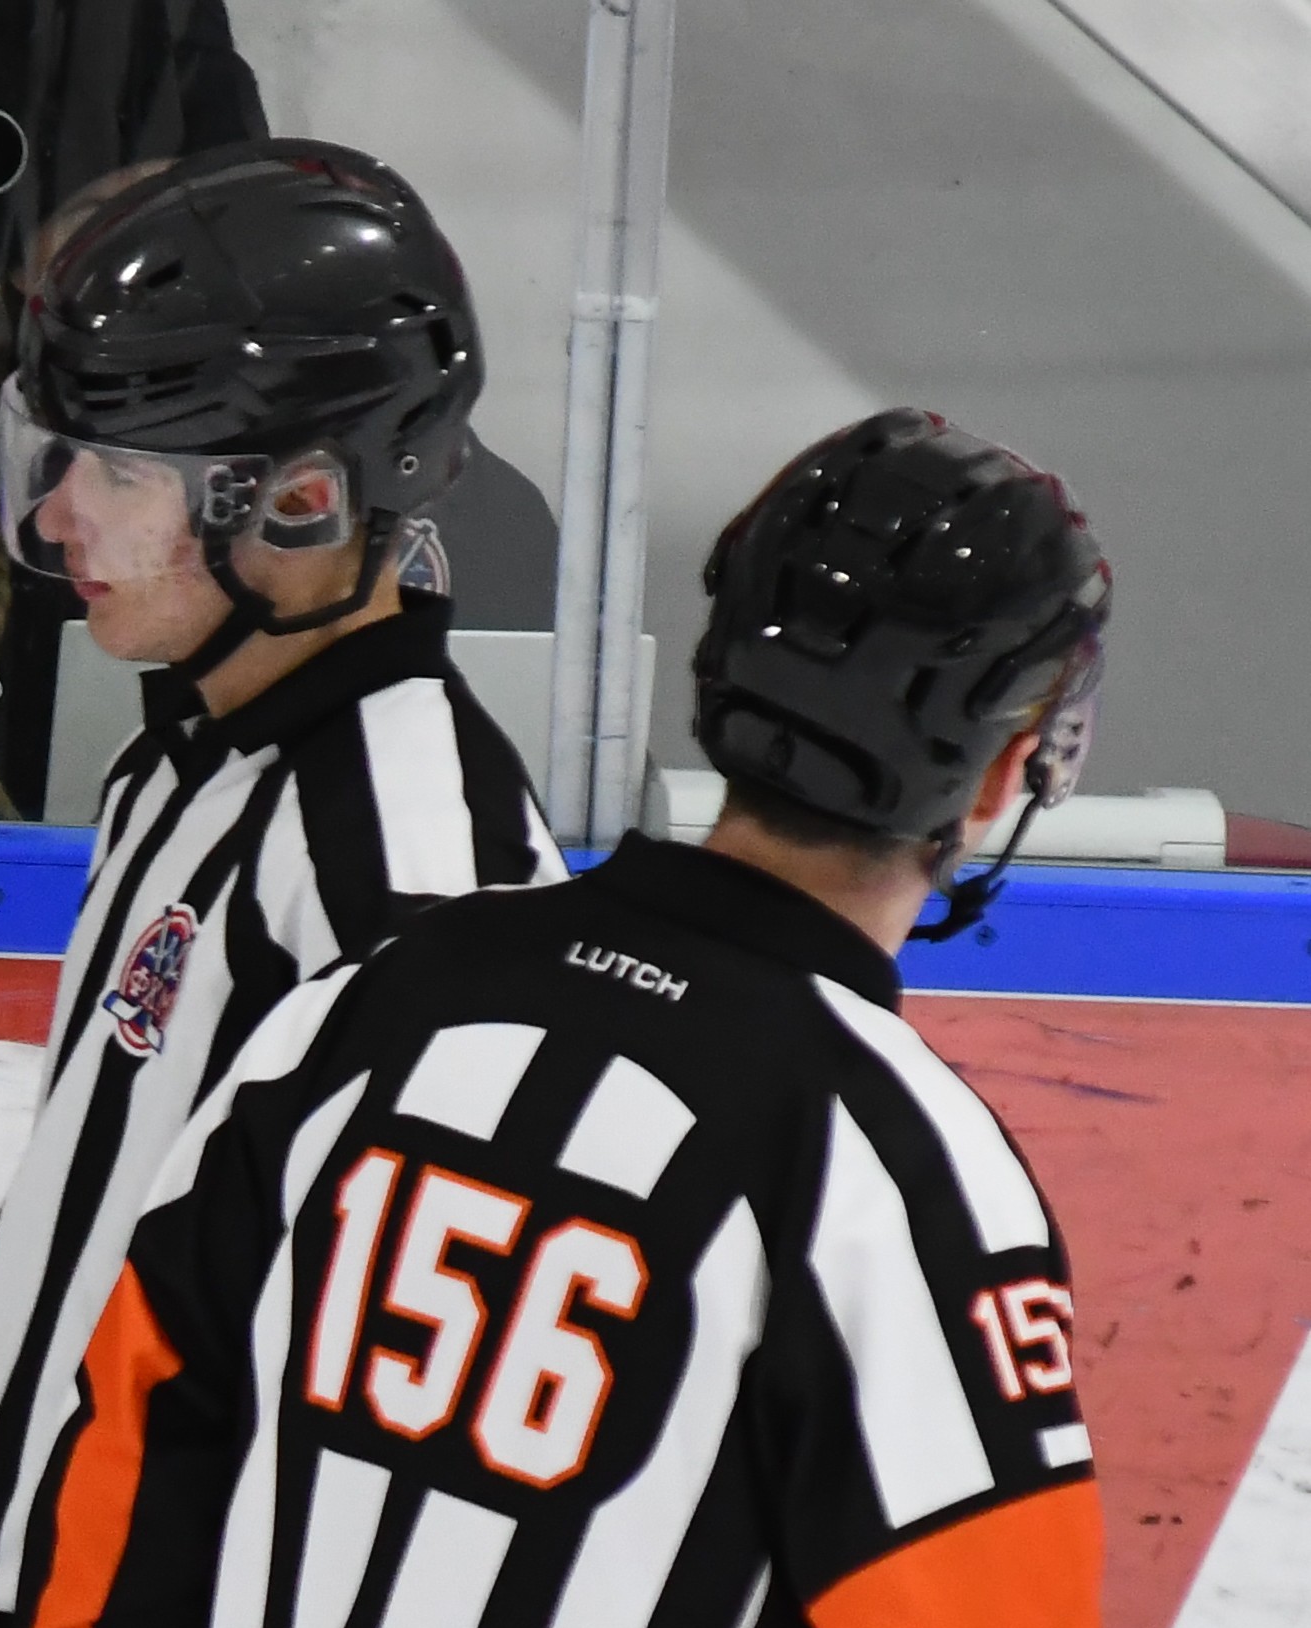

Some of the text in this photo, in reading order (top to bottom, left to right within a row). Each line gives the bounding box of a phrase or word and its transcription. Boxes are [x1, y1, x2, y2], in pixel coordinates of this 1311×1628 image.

[566, 941, 689, 1001] LUTCH
[305, 1145, 650, 1490] 156
[969, 1276, 1074, 1402] 15
